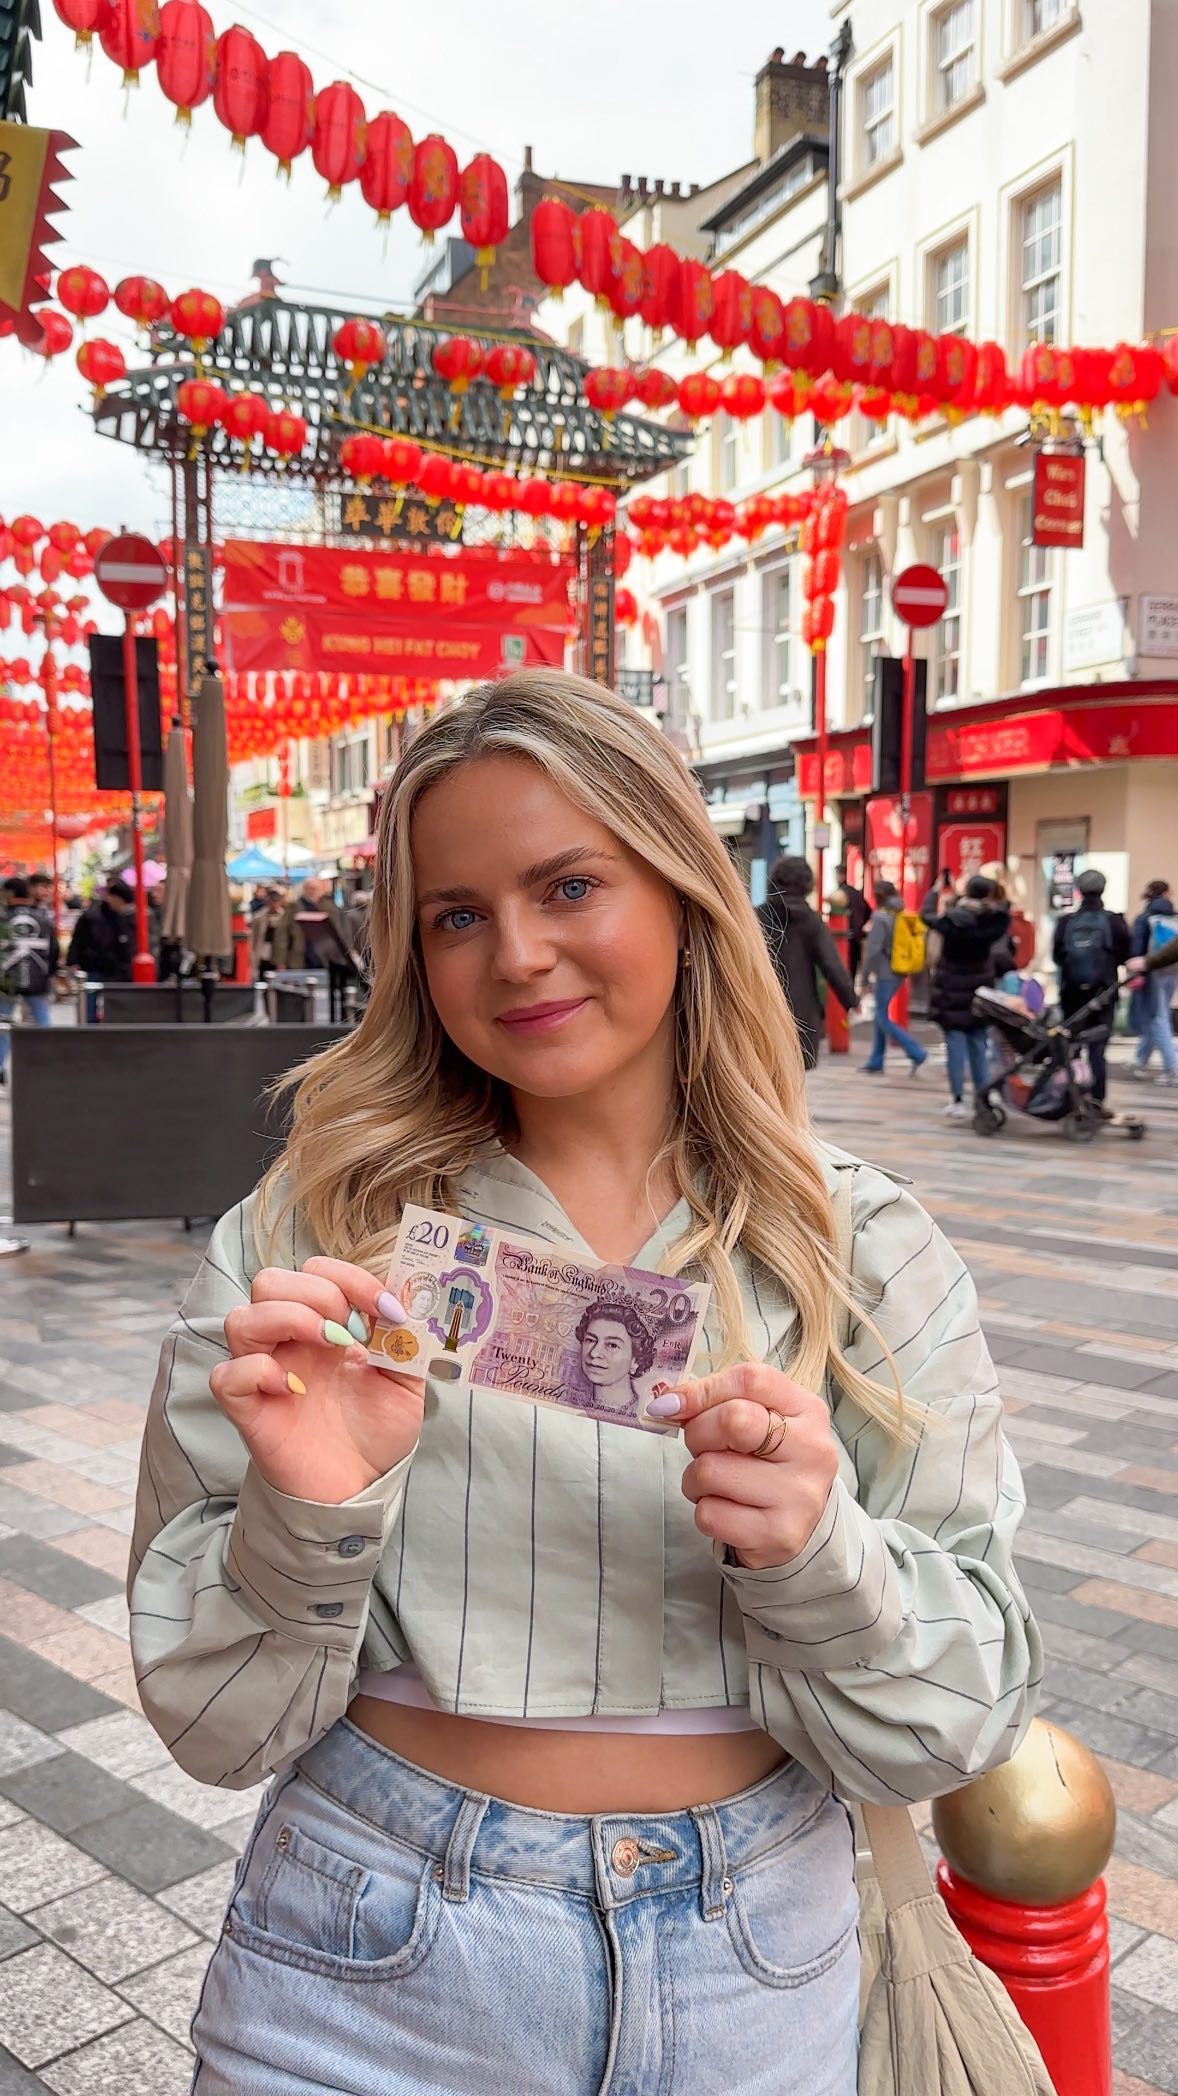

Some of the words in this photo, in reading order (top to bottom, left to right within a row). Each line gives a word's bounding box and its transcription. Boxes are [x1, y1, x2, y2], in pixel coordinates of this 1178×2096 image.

[340, 564, 469, 605] 恭喜發財
[406, 1221, 449, 1249] £20
[502, 1245, 552, 1276] Bank
[560, 1264, 617, 1295] England
[645, 1288, 691, 1322] 20
[493, 1346, 539, 1368] Twenty
[487, 1361, 567, 1398] Pounds
